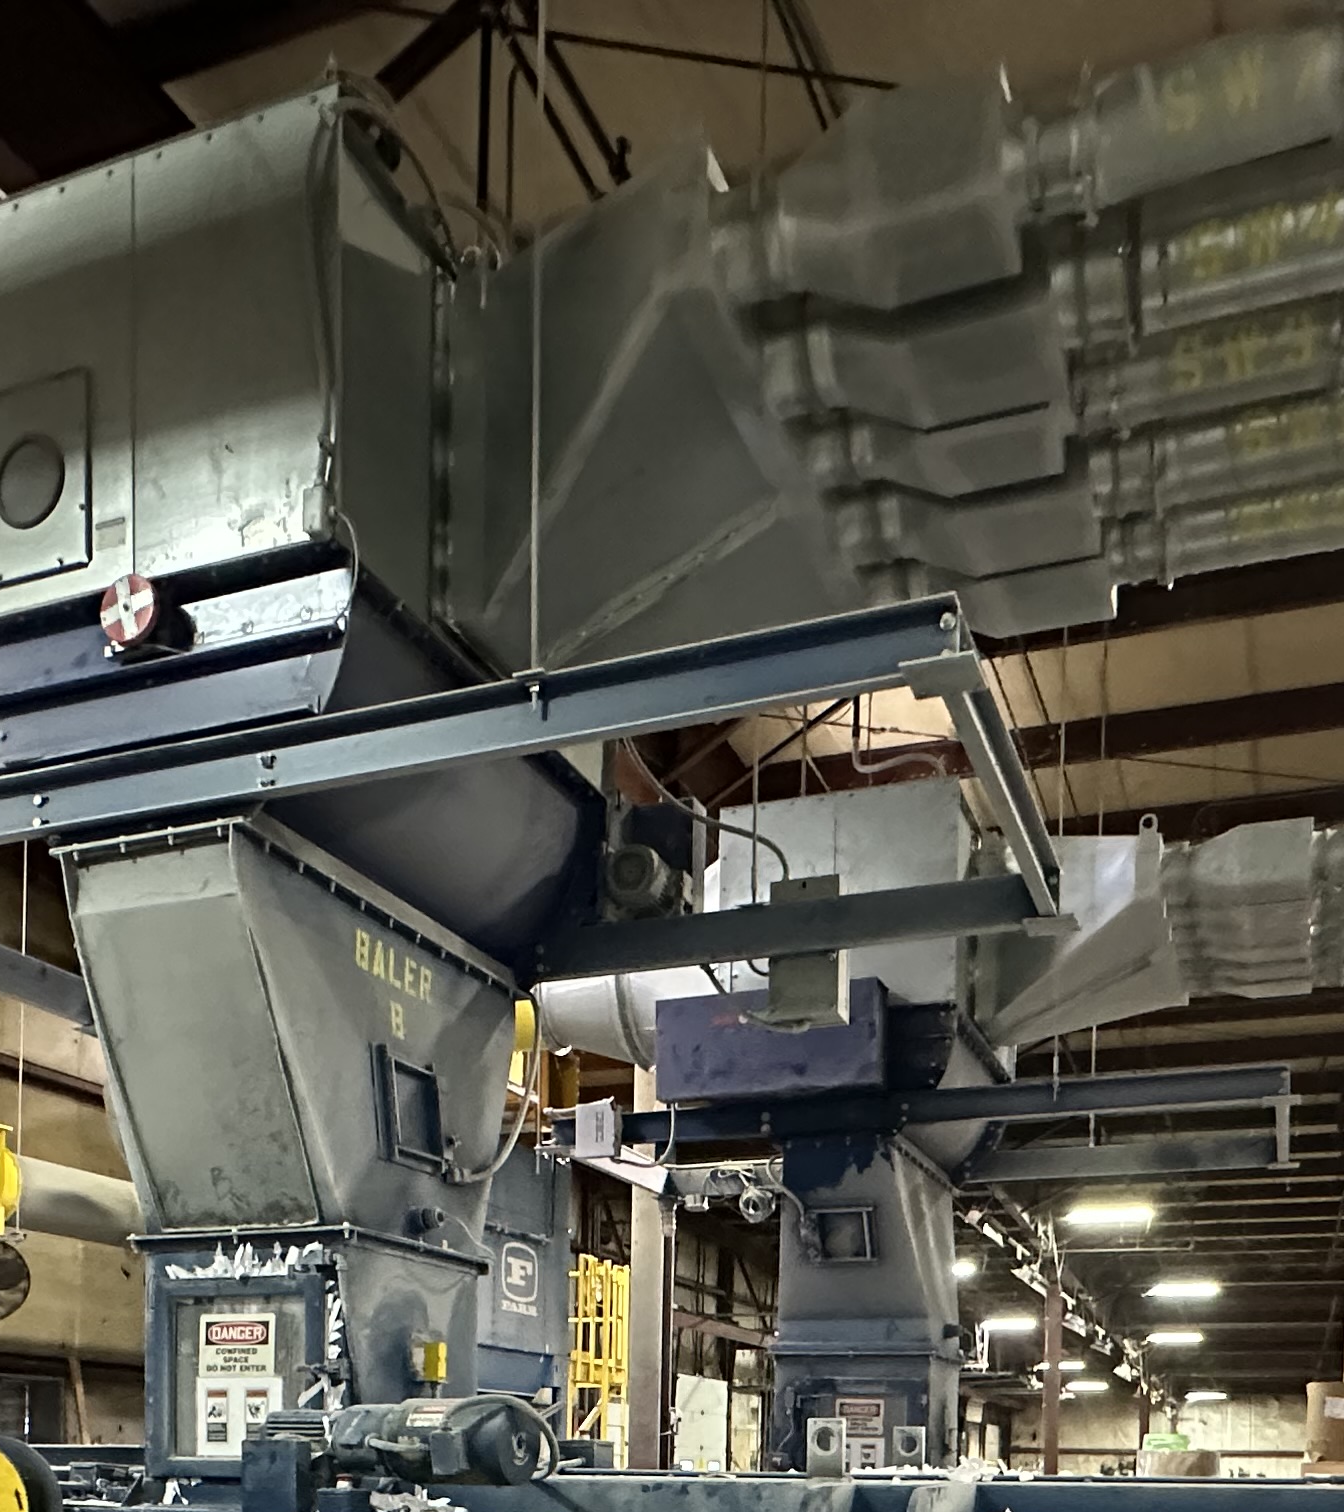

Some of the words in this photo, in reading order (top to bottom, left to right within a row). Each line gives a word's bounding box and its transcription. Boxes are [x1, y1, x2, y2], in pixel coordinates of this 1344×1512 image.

[355, 927, 432, 1005] BALER
[506, 1256, 533, 1287] F
[212, 1326, 263, 1341] DANGER
[215, 1347, 258, 1355] CONFINED
[223, 1356, 249, 1364] SPACE
[206, 1364, 218, 1373] DO
[220, 1364, 237, 1373] NOT
[239, 1364, 267, 1373] ENTER
